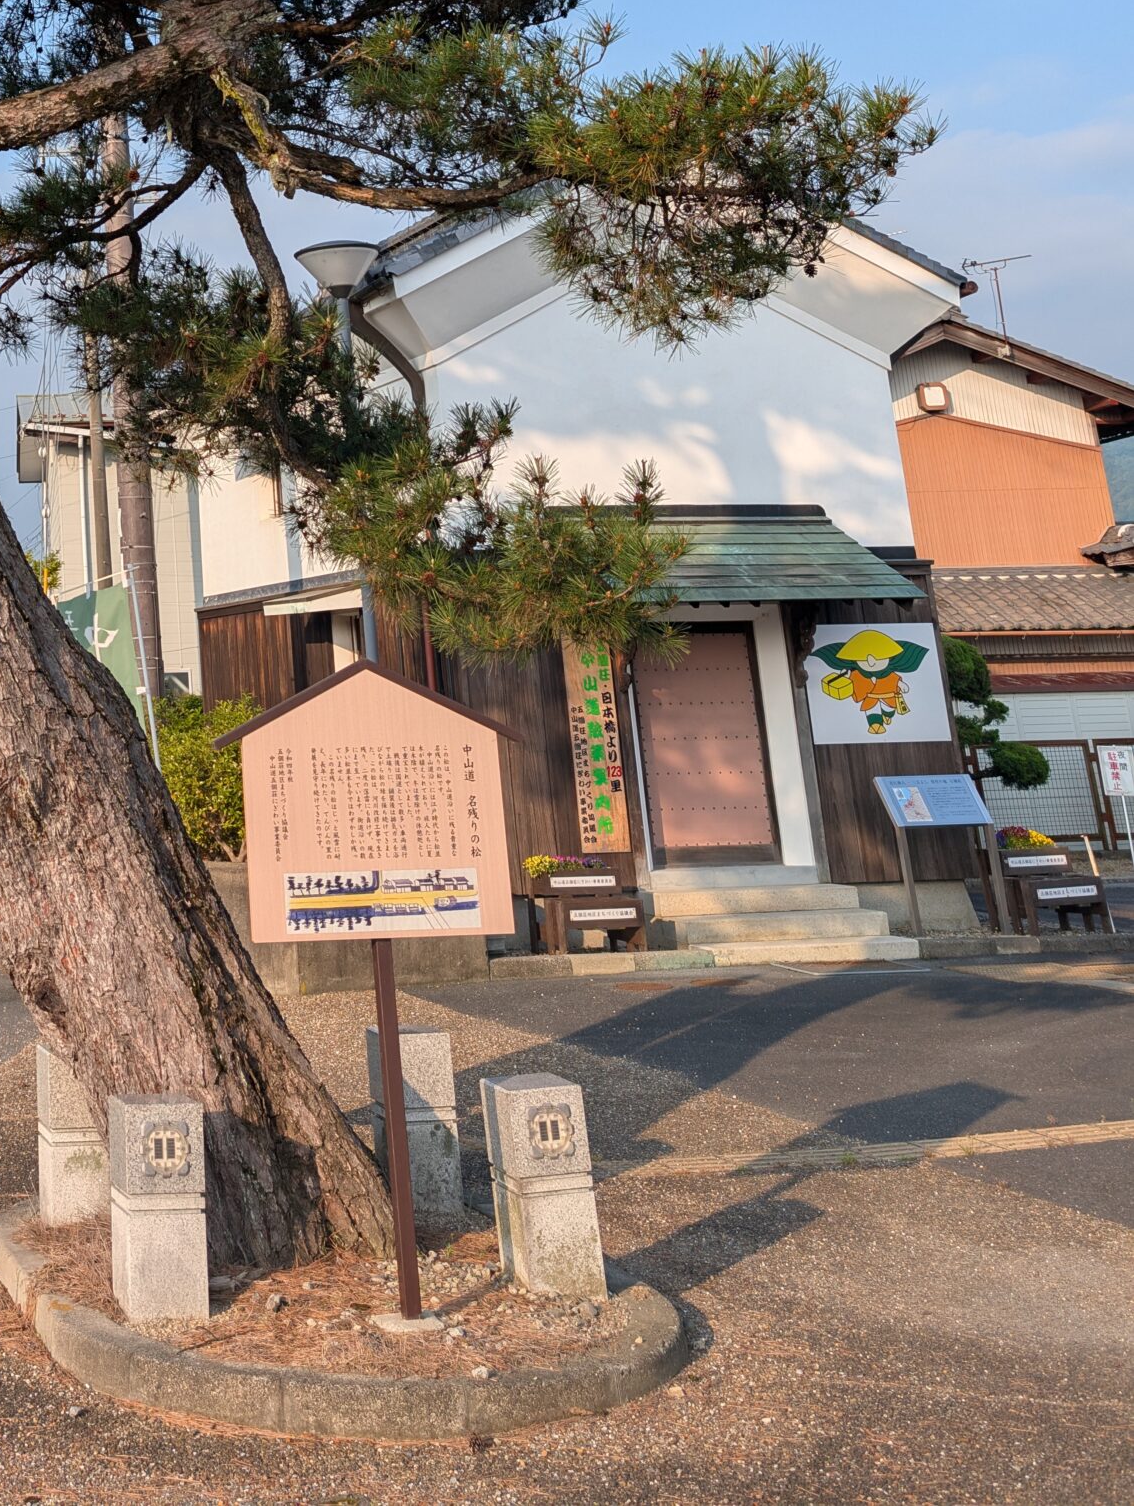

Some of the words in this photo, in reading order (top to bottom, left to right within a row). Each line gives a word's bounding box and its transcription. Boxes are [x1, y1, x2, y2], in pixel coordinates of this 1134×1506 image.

[336, 748, 344, 784] ていません。
[435, 745, 444, 796] 名残りの松です。
[462, 744, 476, 782] 中山道
[1107, 752, 1122, 790] 駐車禁止
[1117, 751, 1128, 771] 夜間
[467, 795, 482, 858] 名残りの松
